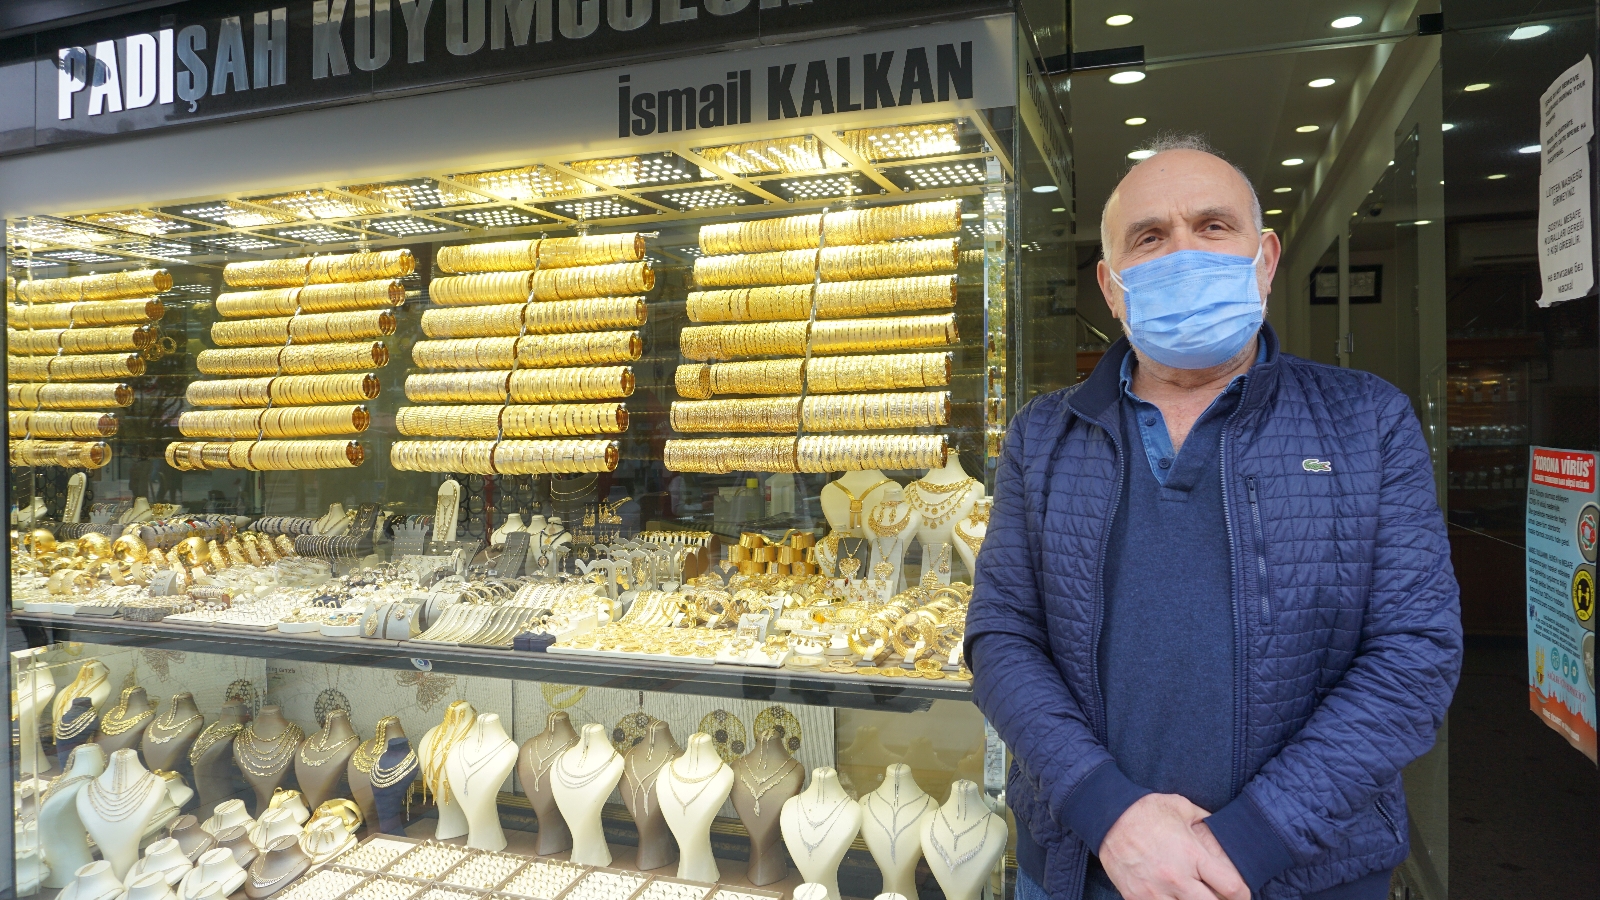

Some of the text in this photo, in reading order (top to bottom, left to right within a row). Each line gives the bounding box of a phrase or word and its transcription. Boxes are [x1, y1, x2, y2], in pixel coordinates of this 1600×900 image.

[58, 0, 813, 119] PADİŞAH KUYUM
[619, 41, 973, 138] İsmail KALKAN
[1563, 208, 1581, 225] MESAFE
